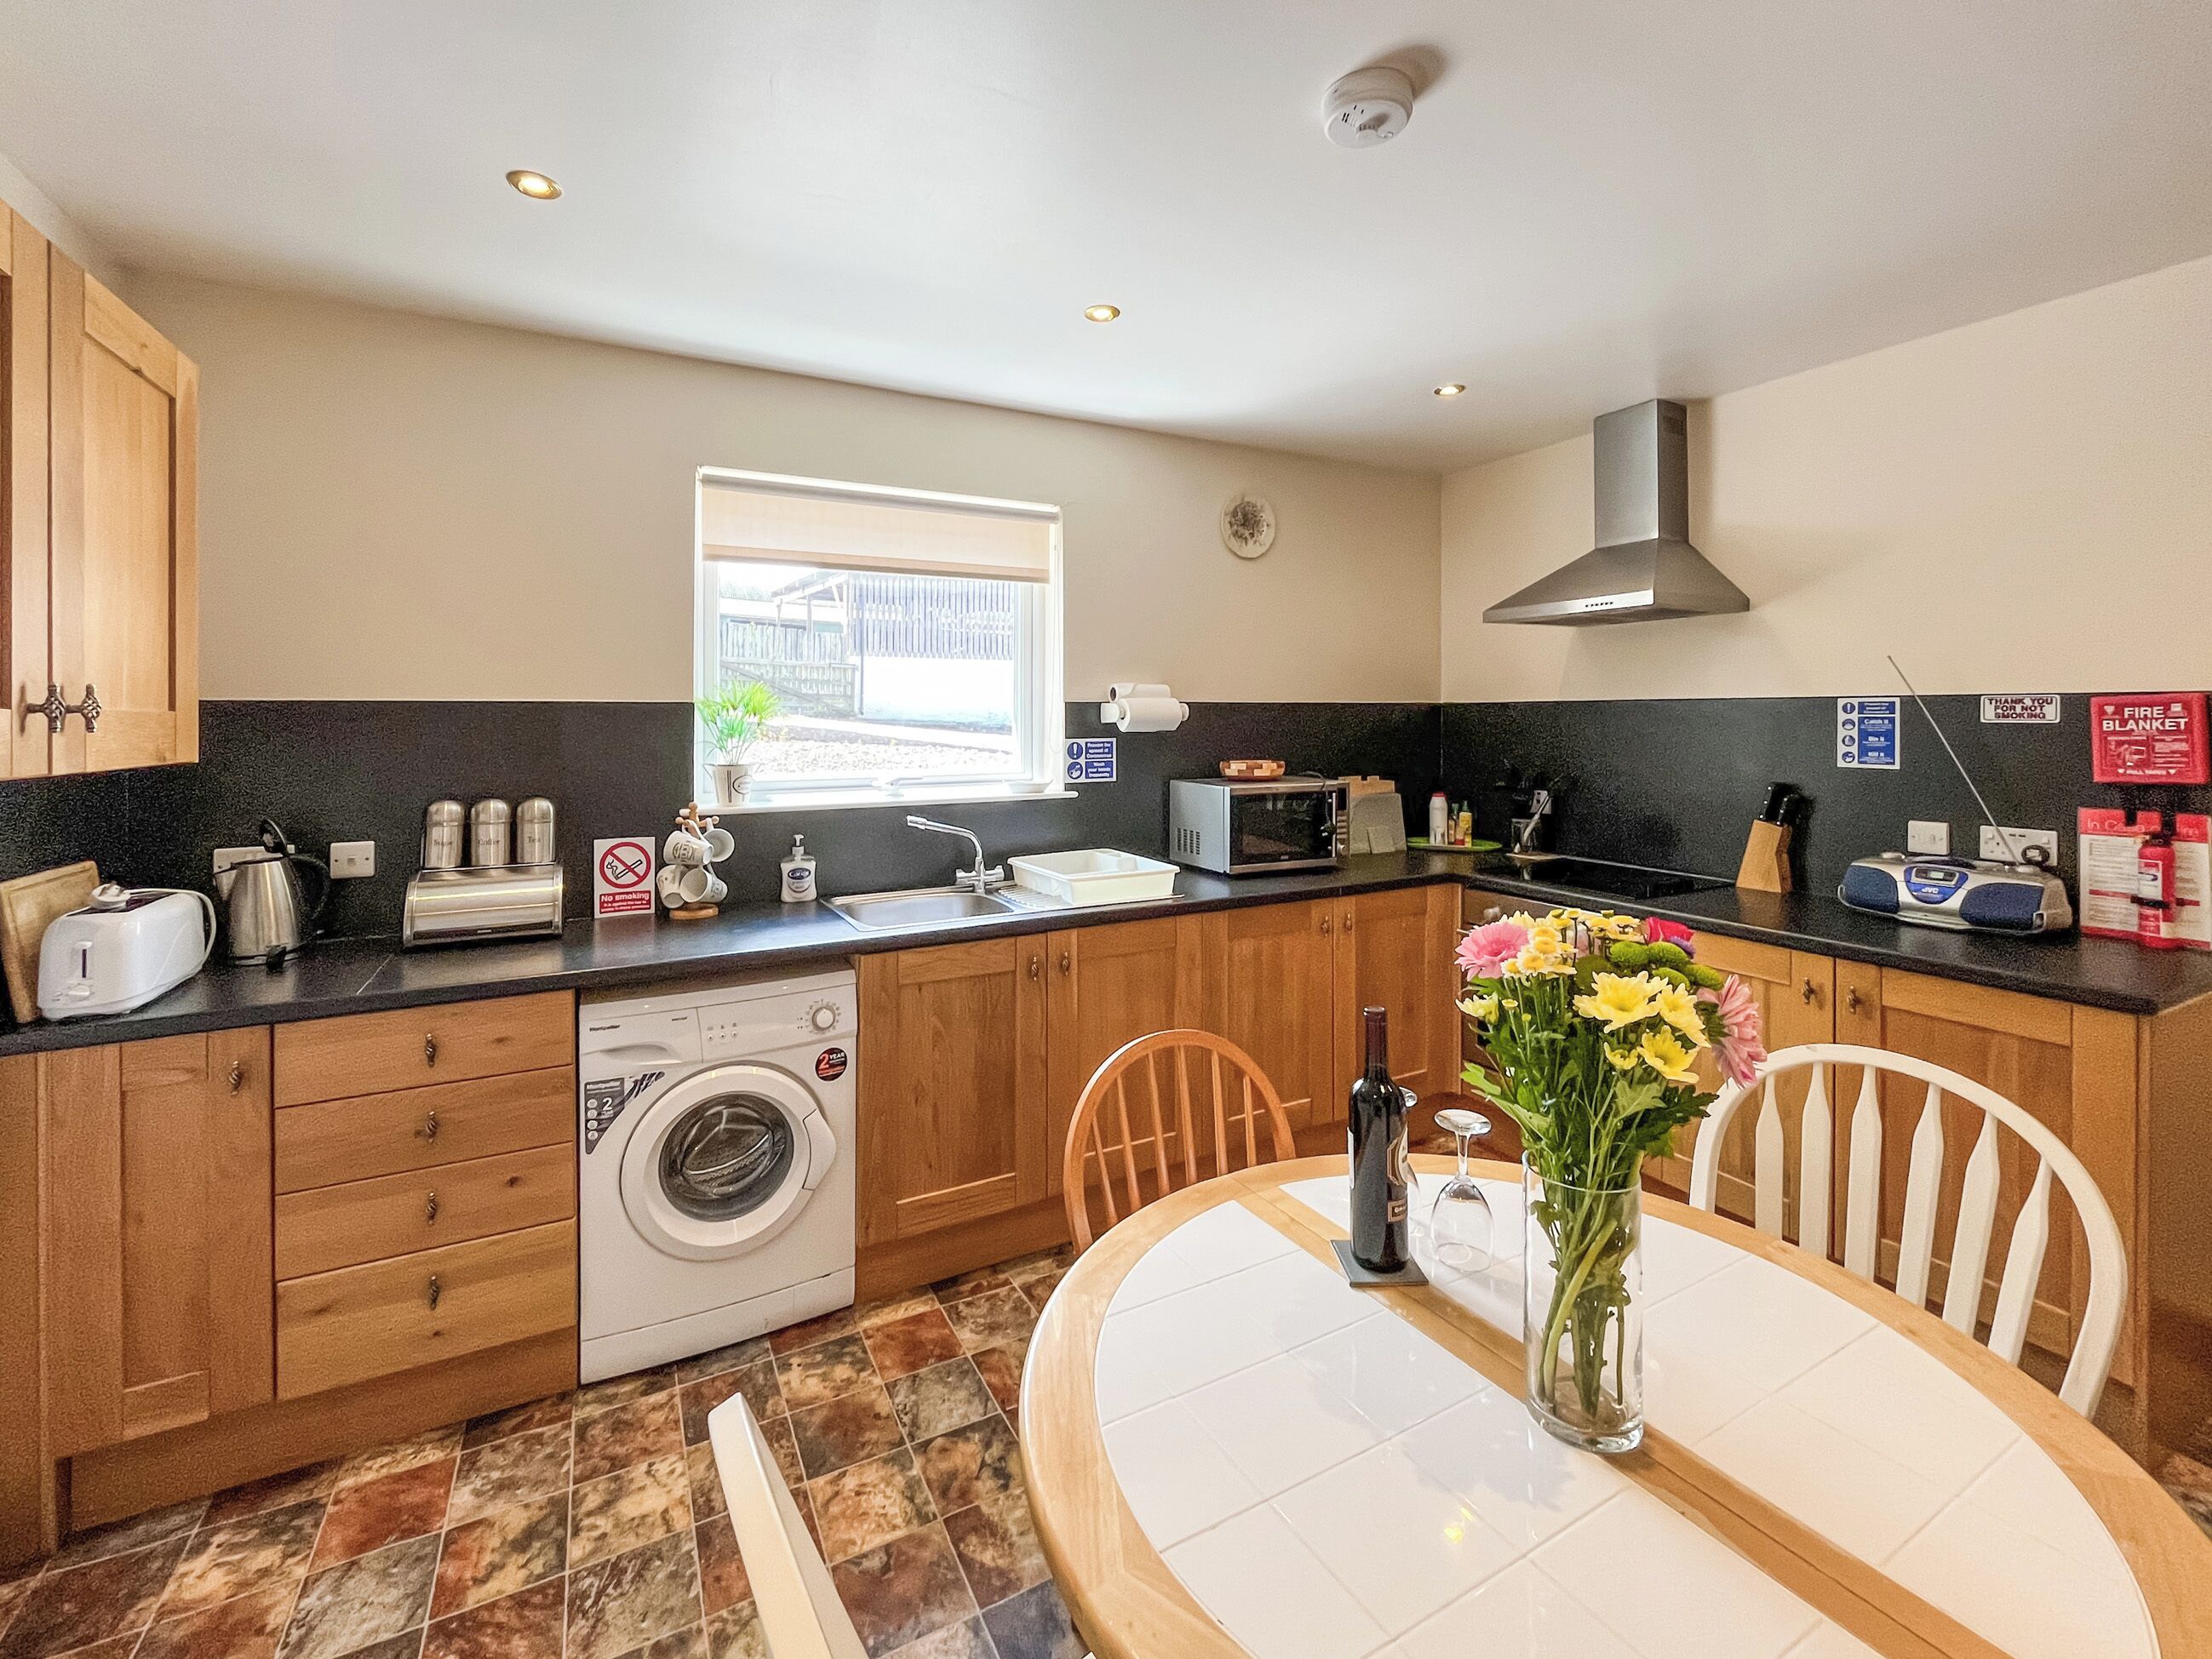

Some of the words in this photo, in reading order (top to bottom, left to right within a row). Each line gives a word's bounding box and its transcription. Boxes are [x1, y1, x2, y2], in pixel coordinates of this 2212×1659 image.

[2123, 707, 2164, 718] FIRE
[2102, 718, 2188, 731] BLANKET
[2088, 818, 2100, 830] In
[615, 892, 650, 901] smoking
[819, 1053, 829, 1070] 2
[602, 1097, 613, 1111] 2
